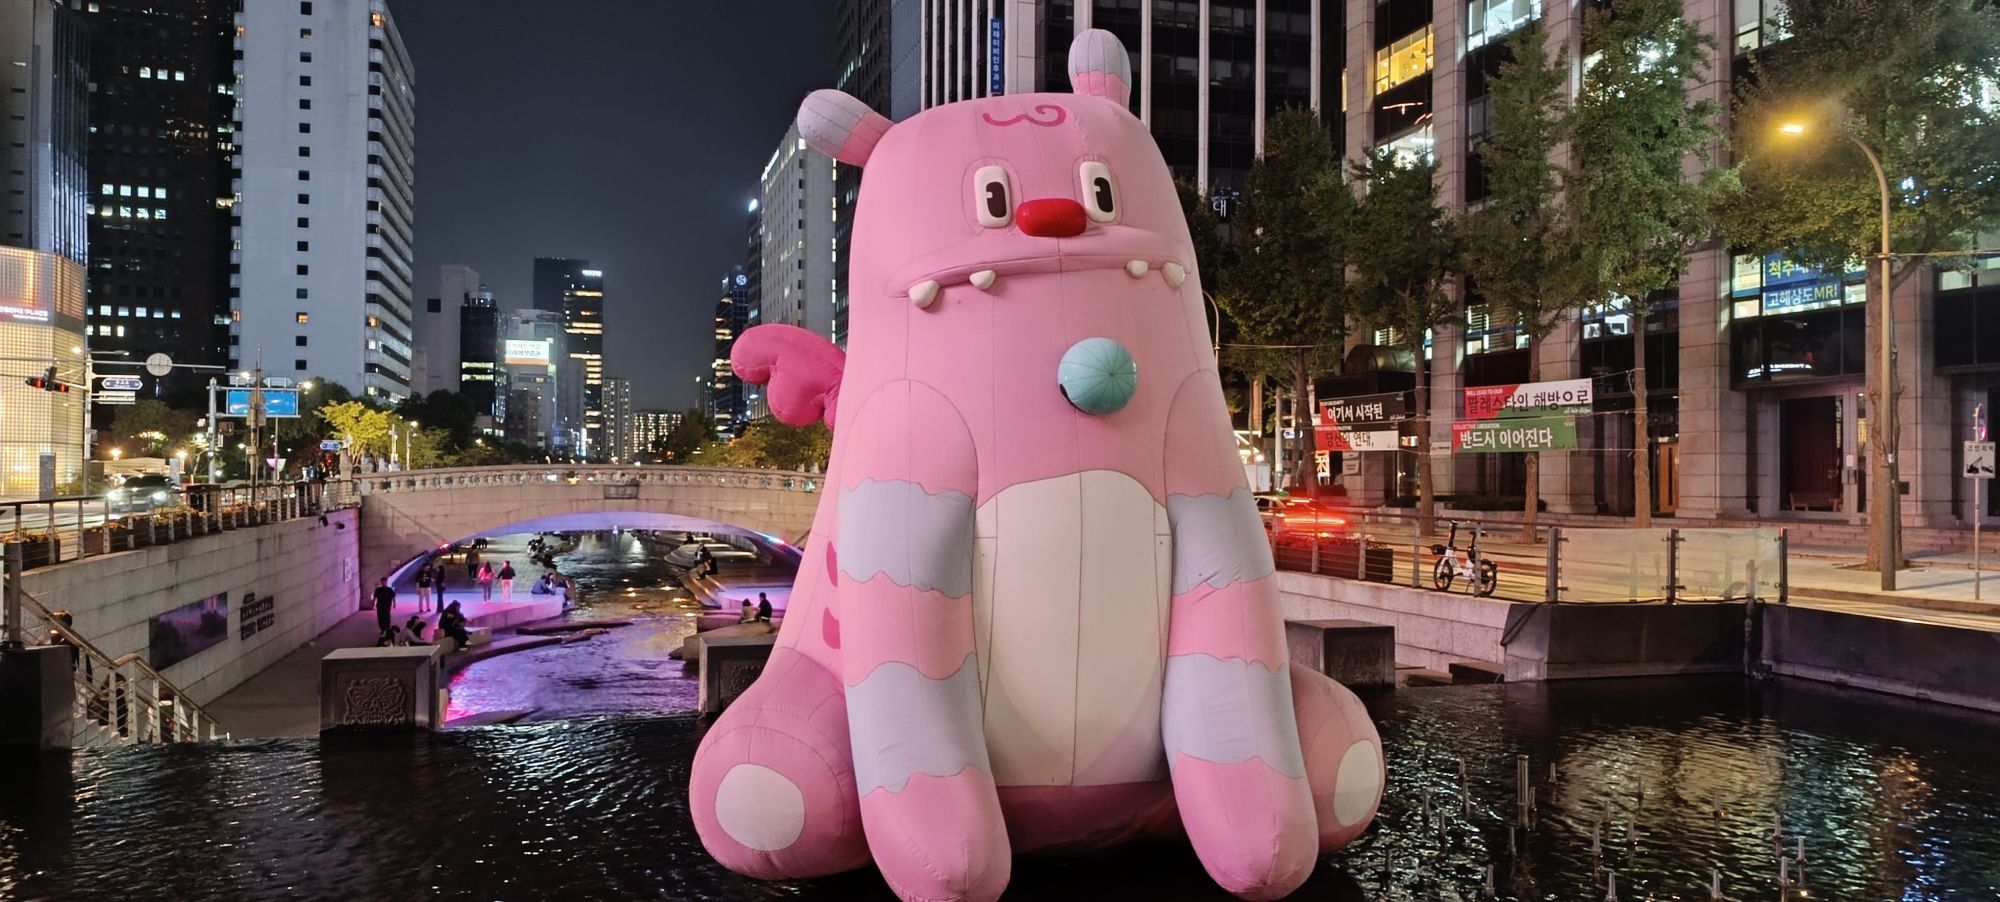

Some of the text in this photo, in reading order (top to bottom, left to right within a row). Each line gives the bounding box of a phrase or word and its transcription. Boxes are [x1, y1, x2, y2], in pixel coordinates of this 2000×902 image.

[1767, 284, 1838, 307] 고해상도MRI
[1327, 404, 1354, 422] 여기서
[1355, 402, 1384, 421] 시작된
[1467, 393, 1529, 414] 팔레스타인
[1533, 389, 1589, 411] 해방으로
[1325, 431, 1350, 447] 당신의
[1460, 427, 1553, 449] 반드시 이어진다
